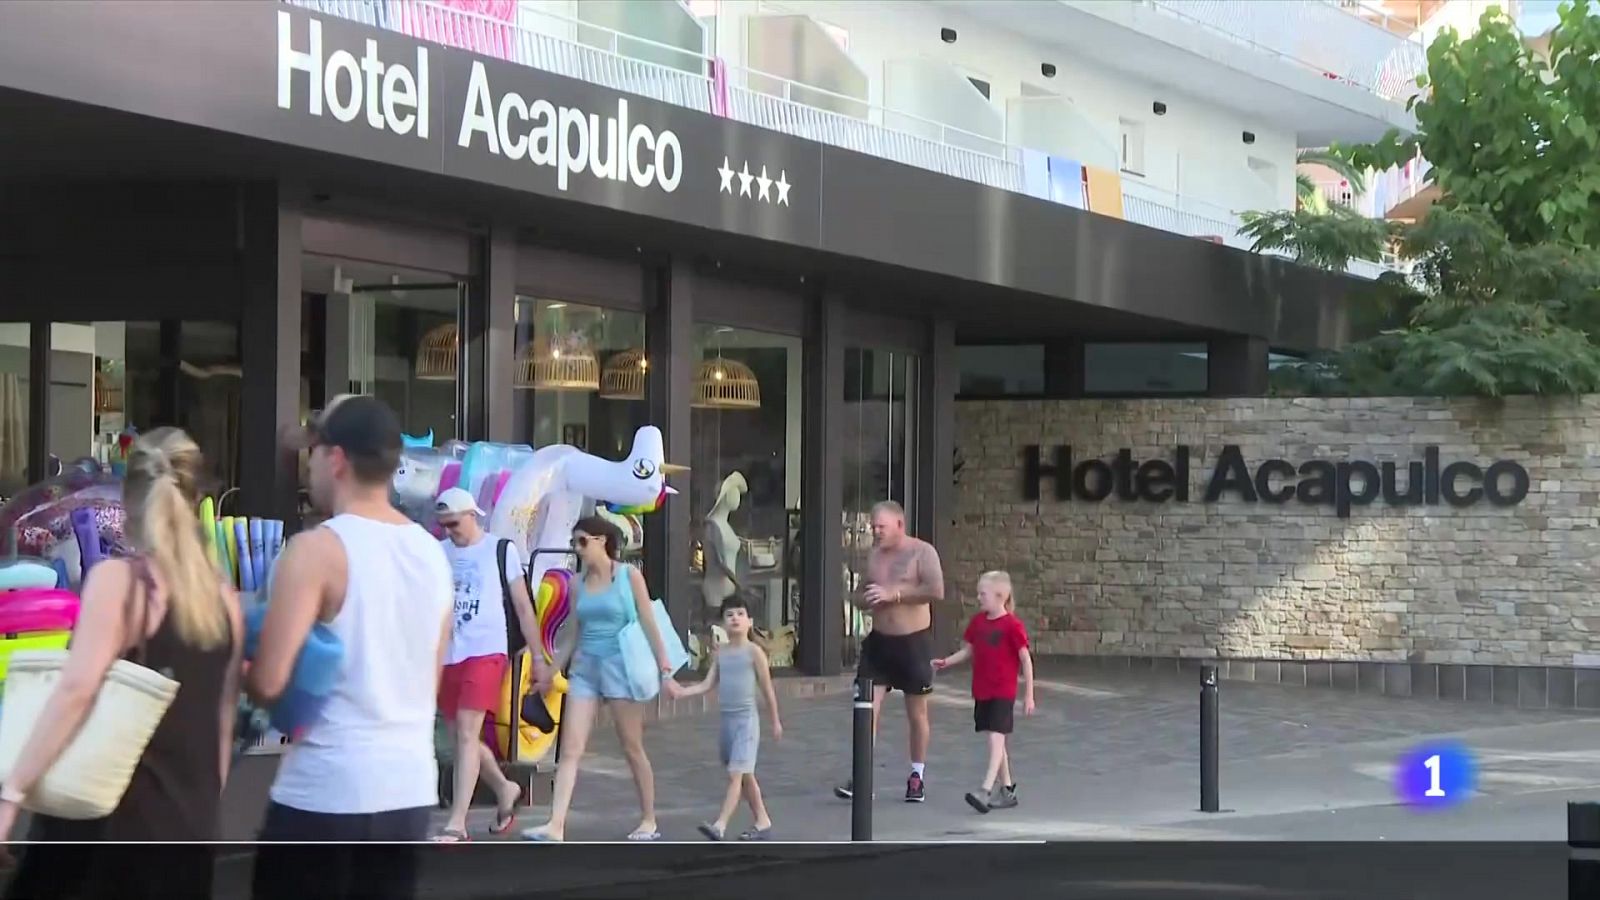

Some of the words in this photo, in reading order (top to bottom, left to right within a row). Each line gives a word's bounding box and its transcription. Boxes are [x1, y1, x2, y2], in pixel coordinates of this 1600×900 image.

[277, 10, 429, 140] Hotel
[457, 60, 683, 193] Acapulco
[1022, 444, 1190, 505] Hotel
[1204, 444, 1531, 518] Acapulco
